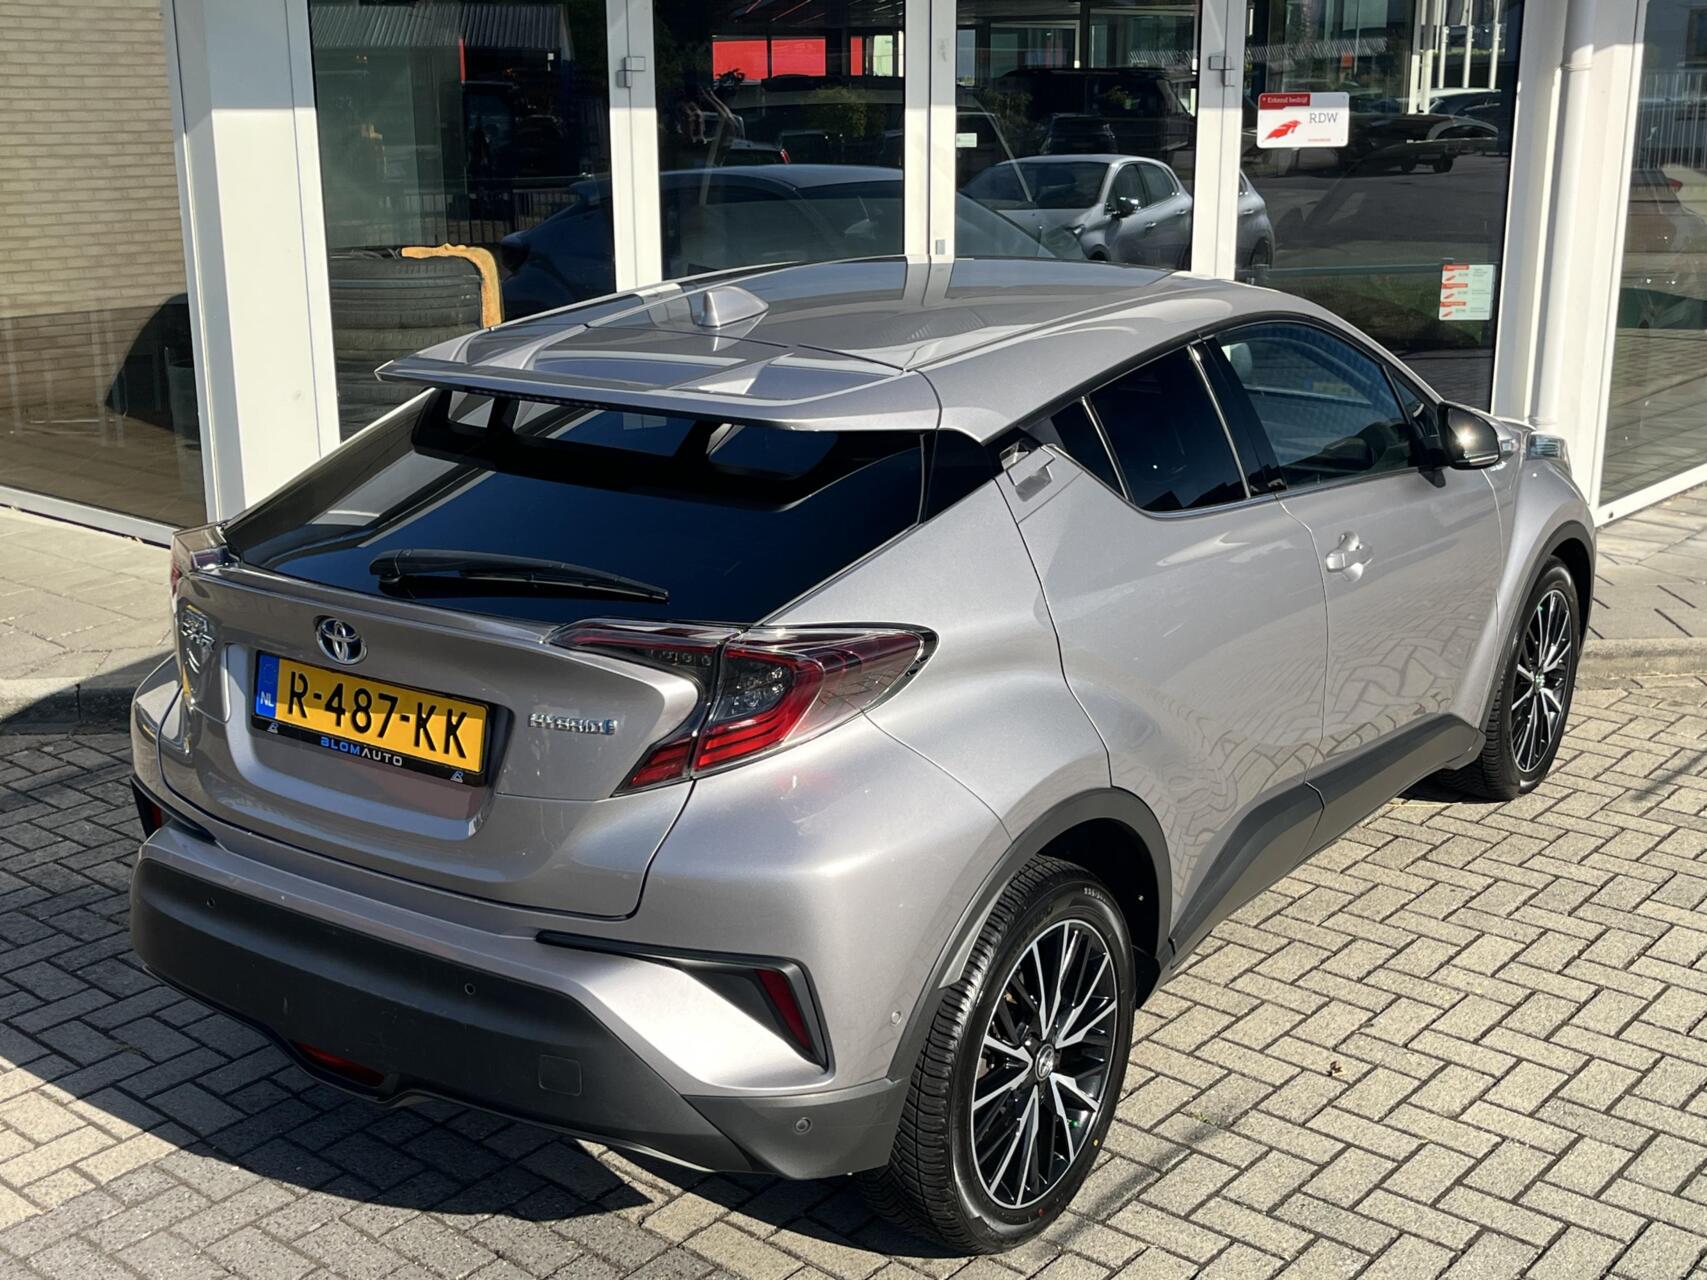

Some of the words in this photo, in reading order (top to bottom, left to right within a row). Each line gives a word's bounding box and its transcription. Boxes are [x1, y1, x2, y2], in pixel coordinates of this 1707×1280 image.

[1309, 112, 1338, 124] RDW
[259, 690, 275, 708] NL
[287, 671, 468, 759] R-487-KK
